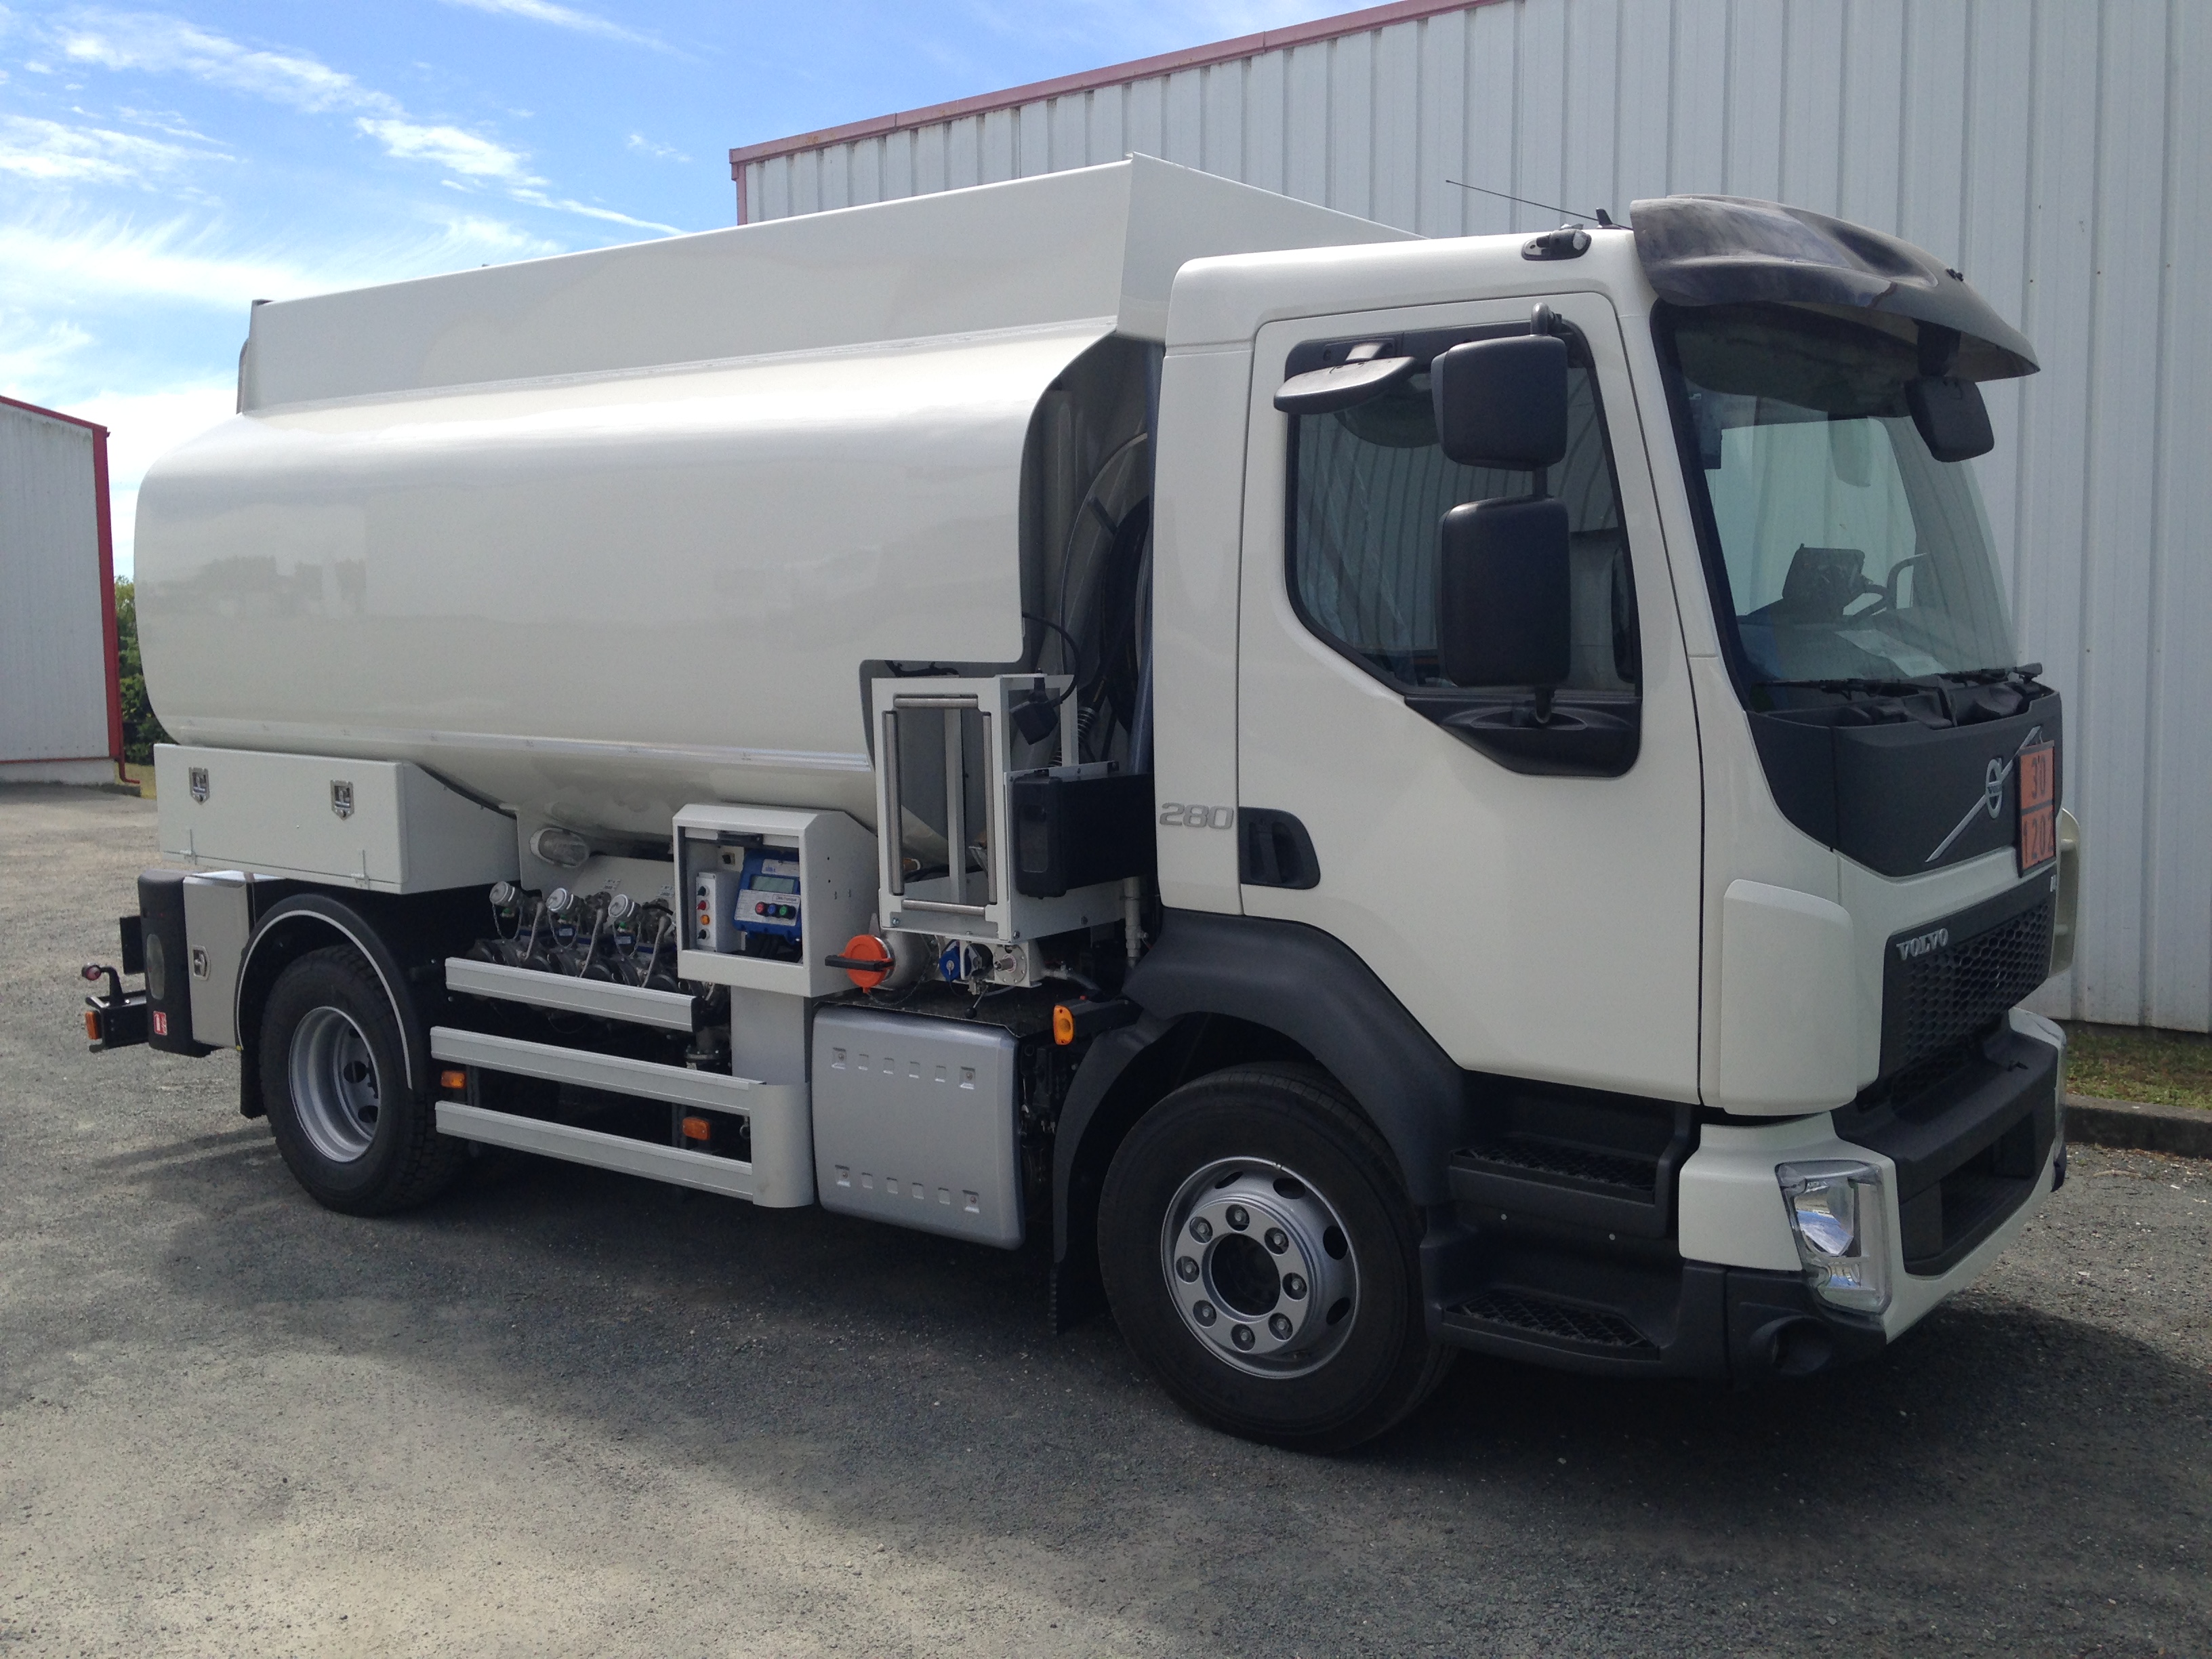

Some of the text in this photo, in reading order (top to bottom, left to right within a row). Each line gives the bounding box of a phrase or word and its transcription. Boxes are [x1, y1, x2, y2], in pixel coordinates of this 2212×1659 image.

[2032, 754, 2046, 799] 30
[1159, 802, 1234, 830] 280
[2024, 811, 2053, 864] 1202
[1896, 928, 1948, 960] VOLVO
